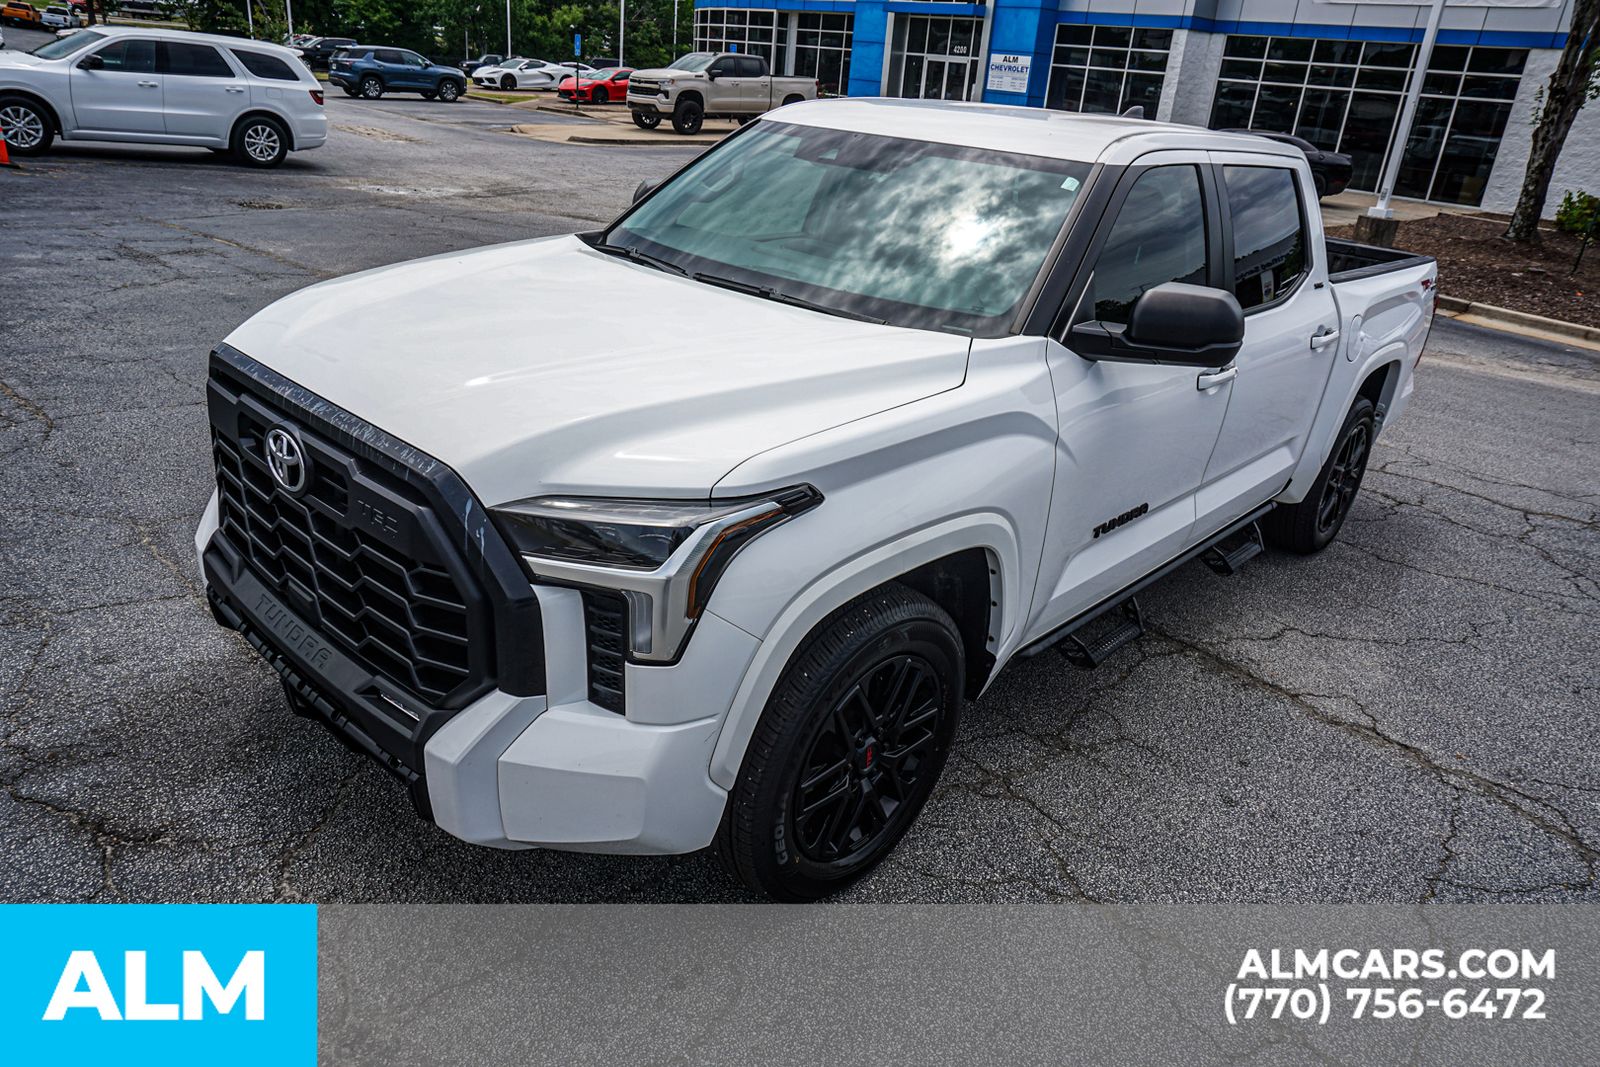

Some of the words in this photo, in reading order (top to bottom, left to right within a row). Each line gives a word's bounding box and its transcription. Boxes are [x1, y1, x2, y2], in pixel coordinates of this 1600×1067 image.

[953, 45, 968, 54] 4200
[1002, 55, 1019, 63] ALM
[990, 63, 1029, 73] CHEVROLET
[1092, 502, 1149, 539] TUNDRA
[254, 592, 332, 670] TUNDRA
